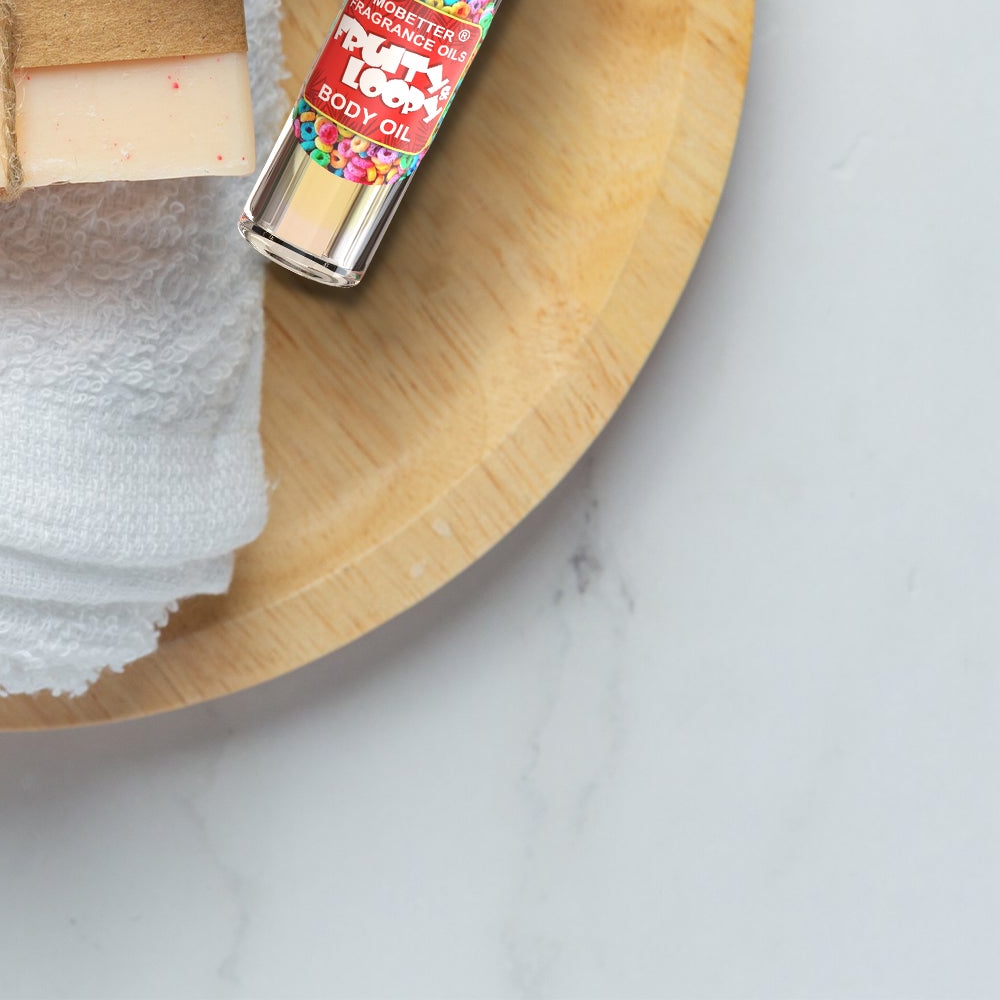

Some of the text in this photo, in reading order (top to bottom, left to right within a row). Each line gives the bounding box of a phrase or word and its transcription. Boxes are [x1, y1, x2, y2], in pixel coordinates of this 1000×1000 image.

[334, 14, 450, 94] FRUITY
[437, 45, 468, 63] OILS
[317, 83, 411, 142] BODY OIL
[341, 55, 443, 124] LOOPY
